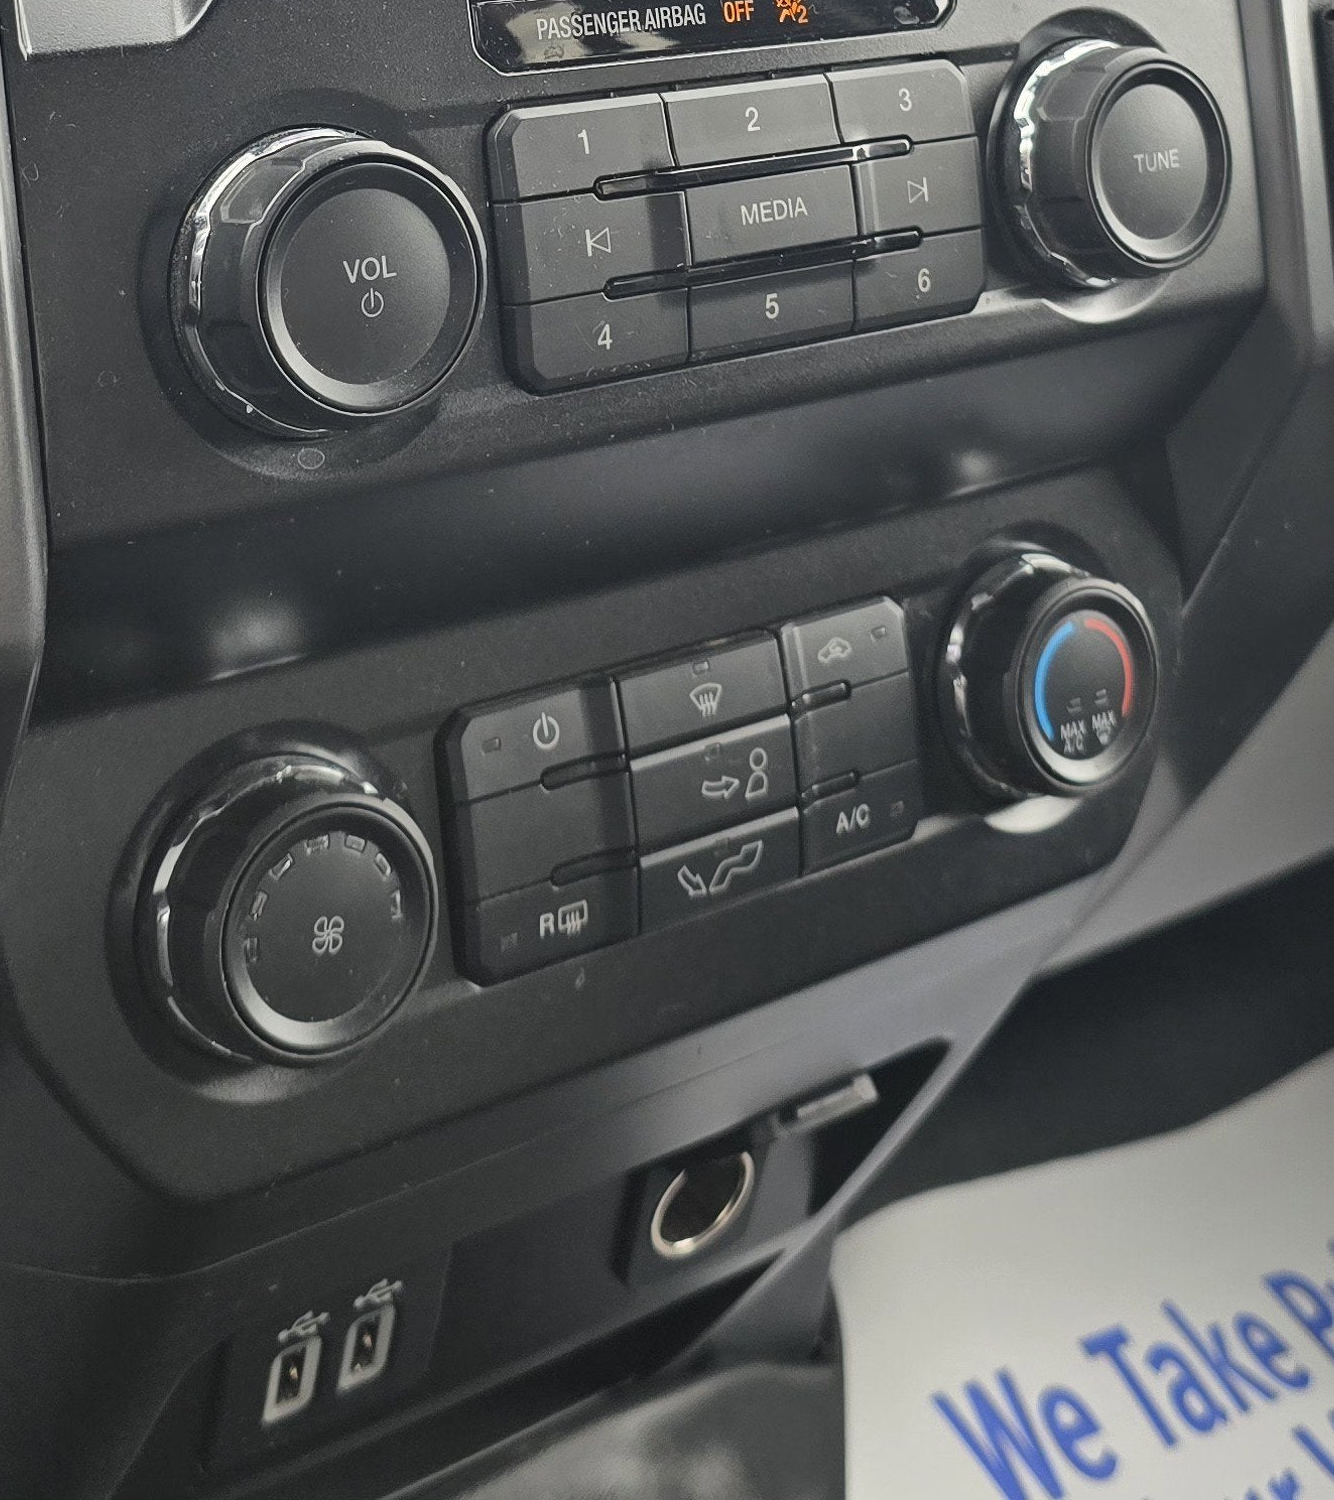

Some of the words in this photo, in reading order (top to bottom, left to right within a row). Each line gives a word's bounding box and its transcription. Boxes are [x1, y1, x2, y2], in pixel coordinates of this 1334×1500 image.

[536, 8, 641, 40] PASSENGER
[644, 2, 706, 29] AIRBAG
[723, 0, 755, 23] OFF
[898, 88, 913, 112] 3
[745, 106, 761, 132] 2
[577, 129, 590, 155] 1
[1133, 149, 1180, 173] TUNE
[740, 197, 808, 226] MEDIA
[343, 255, 397, 284] VOL
[917, 268, 931, 293] 6
[765, 292, 780, 319] 5
[596, 323, 613, 350] 4
[835, 805, 871, 833] A/C
[539, 913, 555, 938] R
[933, 1365, 1118, 1500] We
[1079, 1298, 1311, 1448] Take
